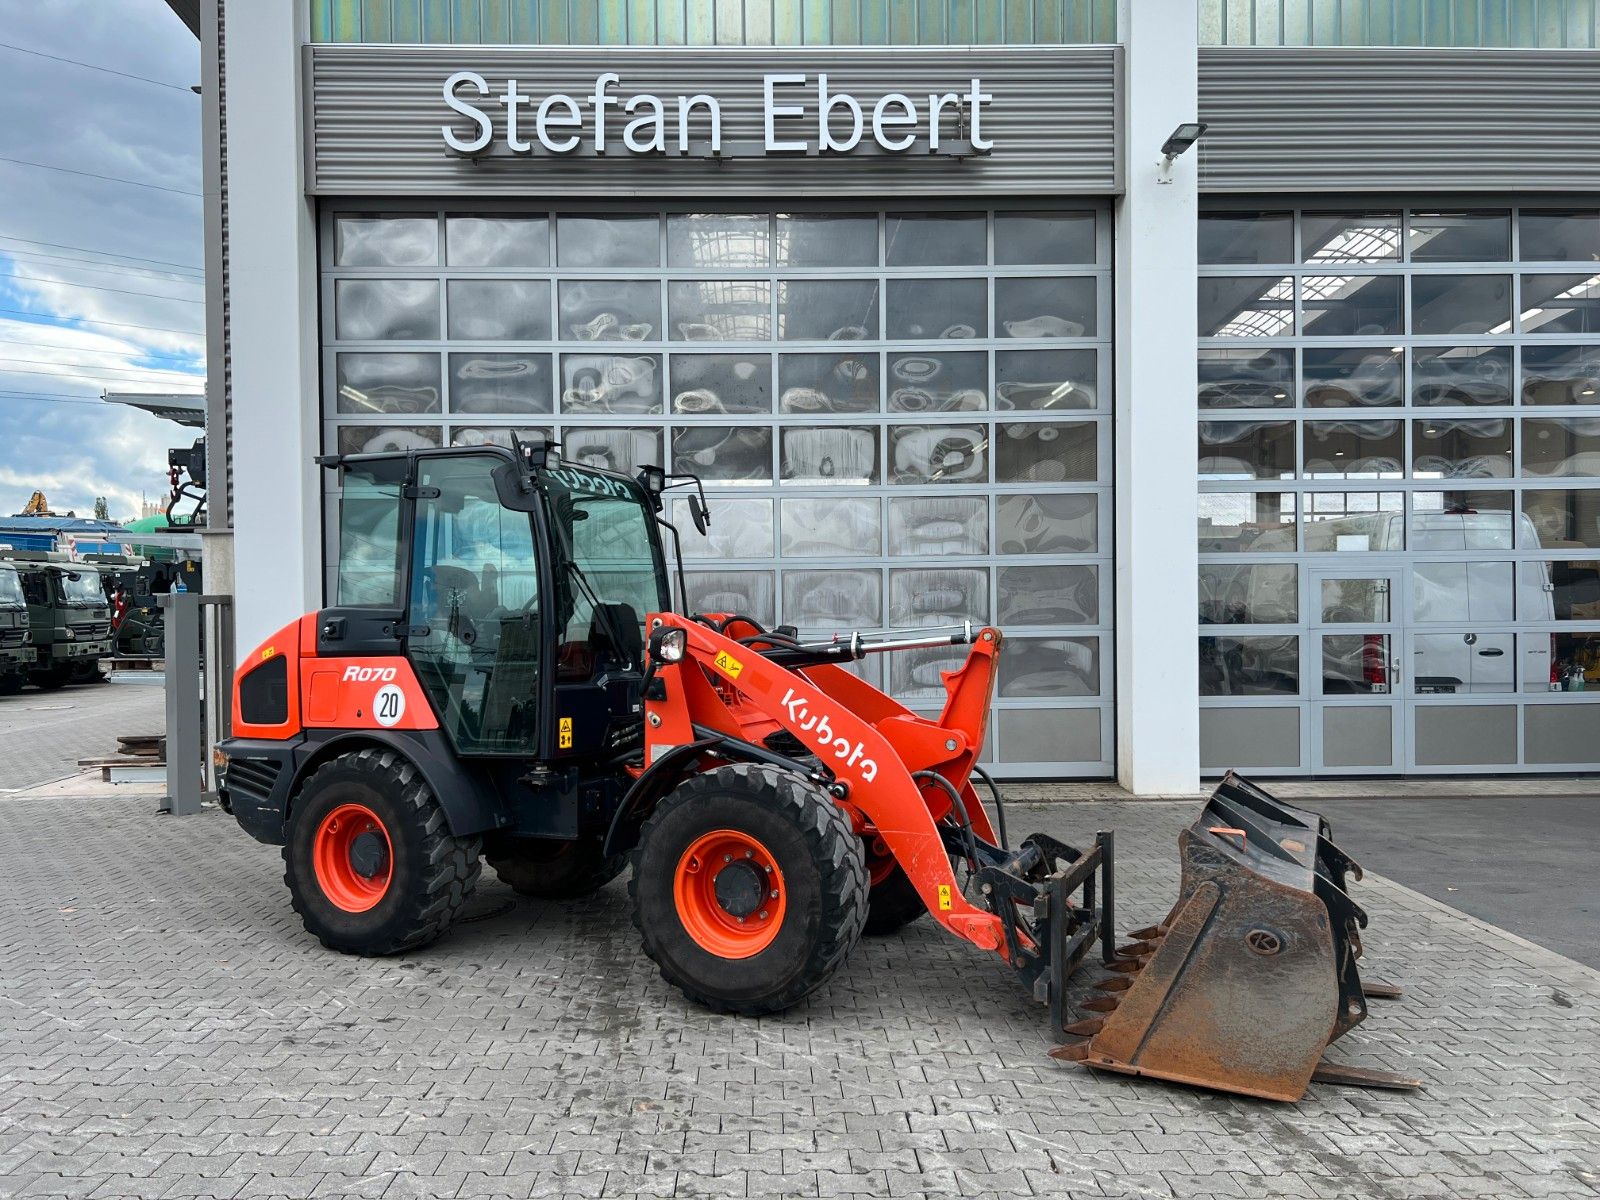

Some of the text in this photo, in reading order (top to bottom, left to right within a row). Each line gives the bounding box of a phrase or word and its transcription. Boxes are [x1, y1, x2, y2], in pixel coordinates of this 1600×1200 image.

[441, 72, 993, 155] Stefan Ebert
[379, 692, 399, 718] 20
[780, 687, 879, 783] Kubota
